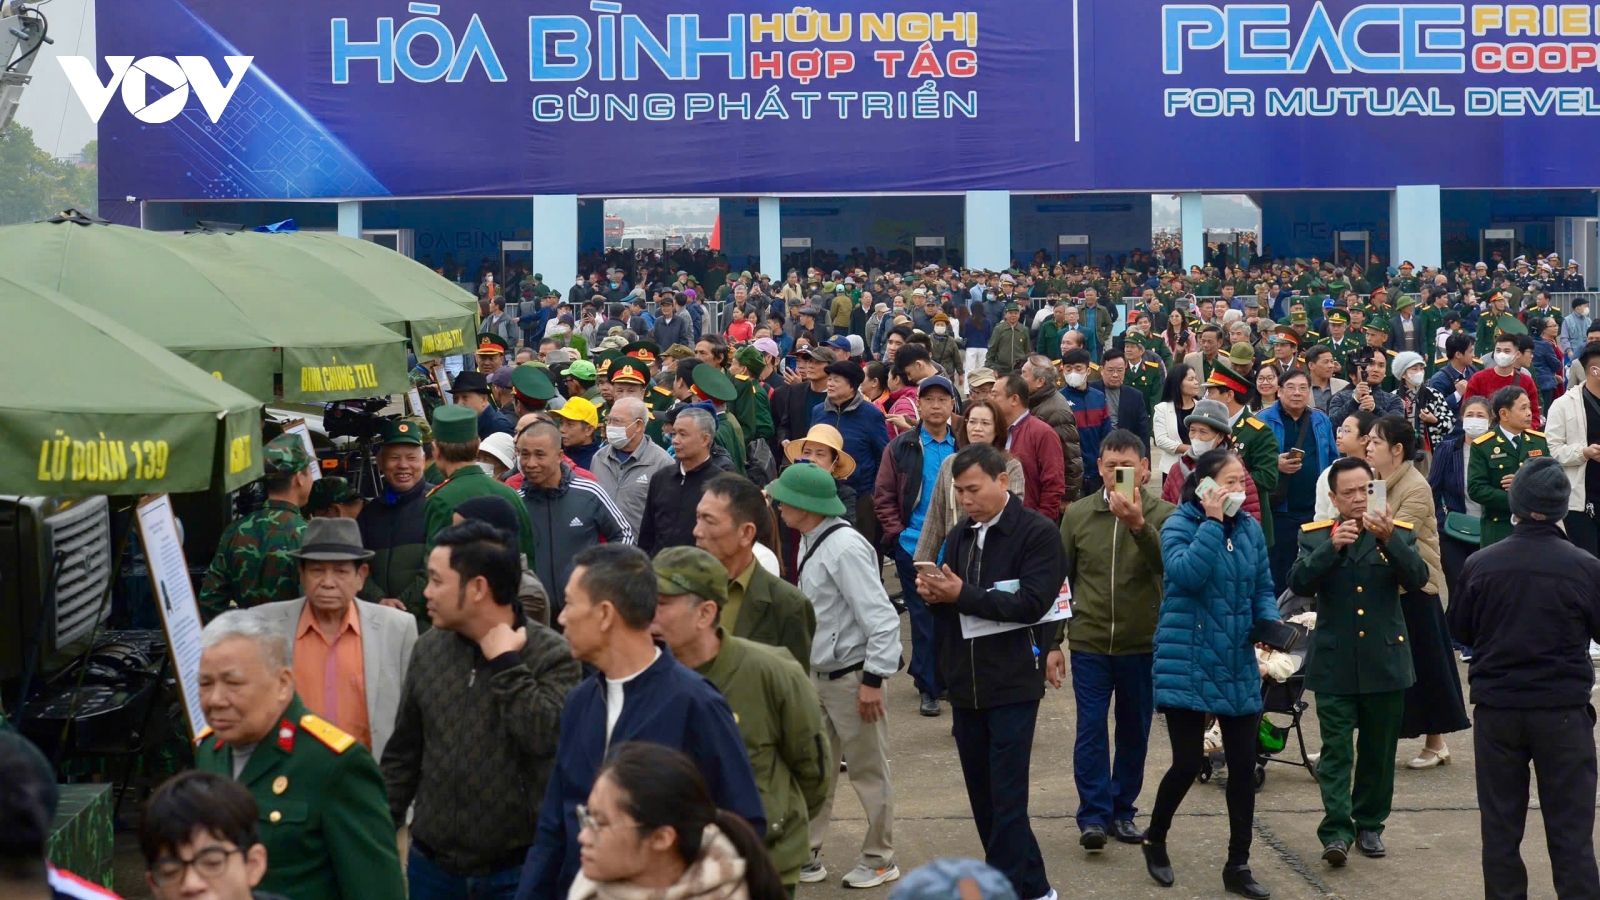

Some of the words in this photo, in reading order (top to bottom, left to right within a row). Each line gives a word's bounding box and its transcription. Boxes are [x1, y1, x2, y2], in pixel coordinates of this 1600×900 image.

[750, 6, 852, 42] HỮU
[860, 12, 977, 47] NGHỊ
[1162, 0, 1465, 74] PEACE
[1472, 5, 1600, 36] FRIE
[331, 2, 508, 84] HÒA
[529, 0, 746, 81] BÌNH
[751, 47, 855, 84] HỢP
[874, 41, 977, 78] TÁC
[1472, 42, 1600, 73] COOP
[533, 87, 675, 122] CÙNG
[684, 85, 821, 120] PHÁT
[828, 80, 977, 119] TRIỂN
[1164, 88, 1255, 117] FOR
[1265, 87, 1455, 116] MUTUAL
[38, 429, 70, 481] LỮ
[71, 431, 128, 481] ĐOÀN
[130, 440, 169, 480] 139
